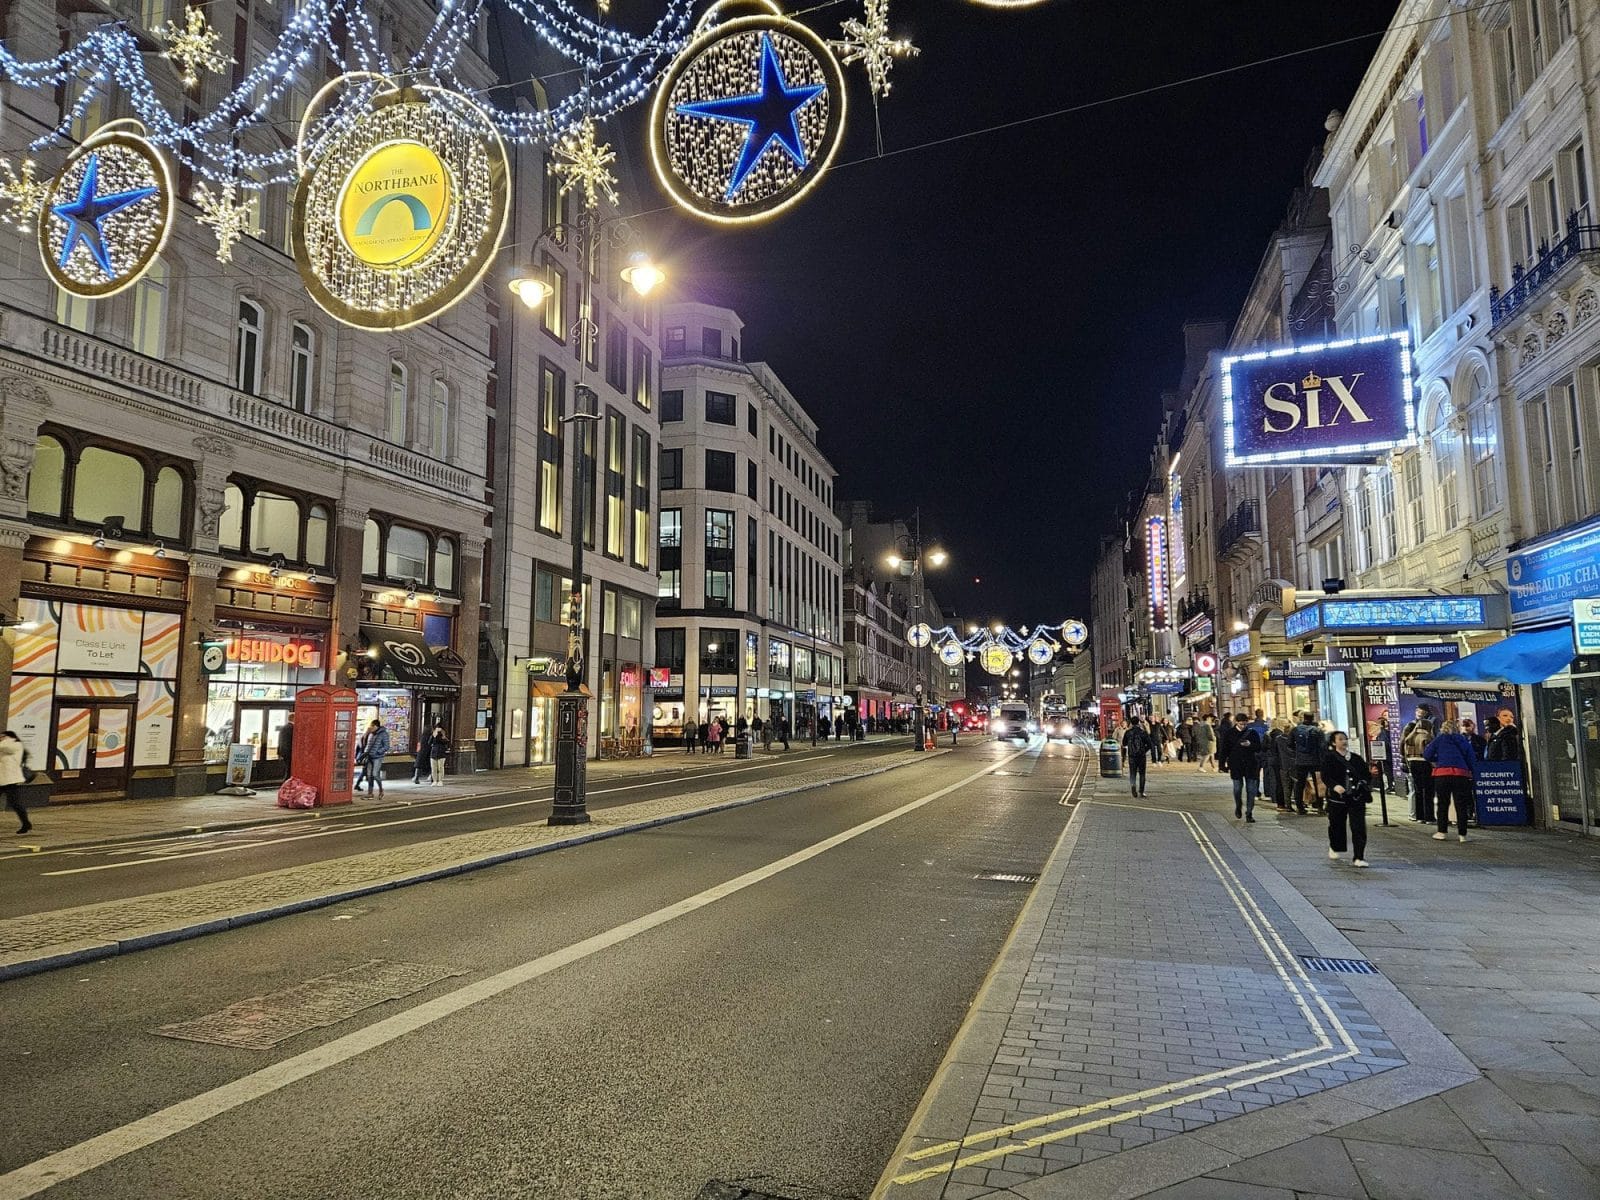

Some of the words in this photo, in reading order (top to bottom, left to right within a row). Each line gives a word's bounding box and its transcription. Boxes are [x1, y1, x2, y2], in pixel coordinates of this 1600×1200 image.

[354, 173, 438, 194] NORTHBANK
[1263, 372, 1374, 433] SIX
[1525, 552, 1548, 566] Thomas
[1549, 541, 1580, 558] Exchange
[1517, 575, 1555, 599] BUREAU
[1558, 570, 1573, 589] DE
[75, 639, 100, 649] Class
[101, 640, 108, 649] E
[109, 641, 126, 650] Unit
[87, 650, 98, 658] To
[99, 650, 114, 659] Let
[227, 639, 313, 666] USHIDOG
[650, 680, 669, 688] LEON
[1369, 696, 1383, 704] THE
